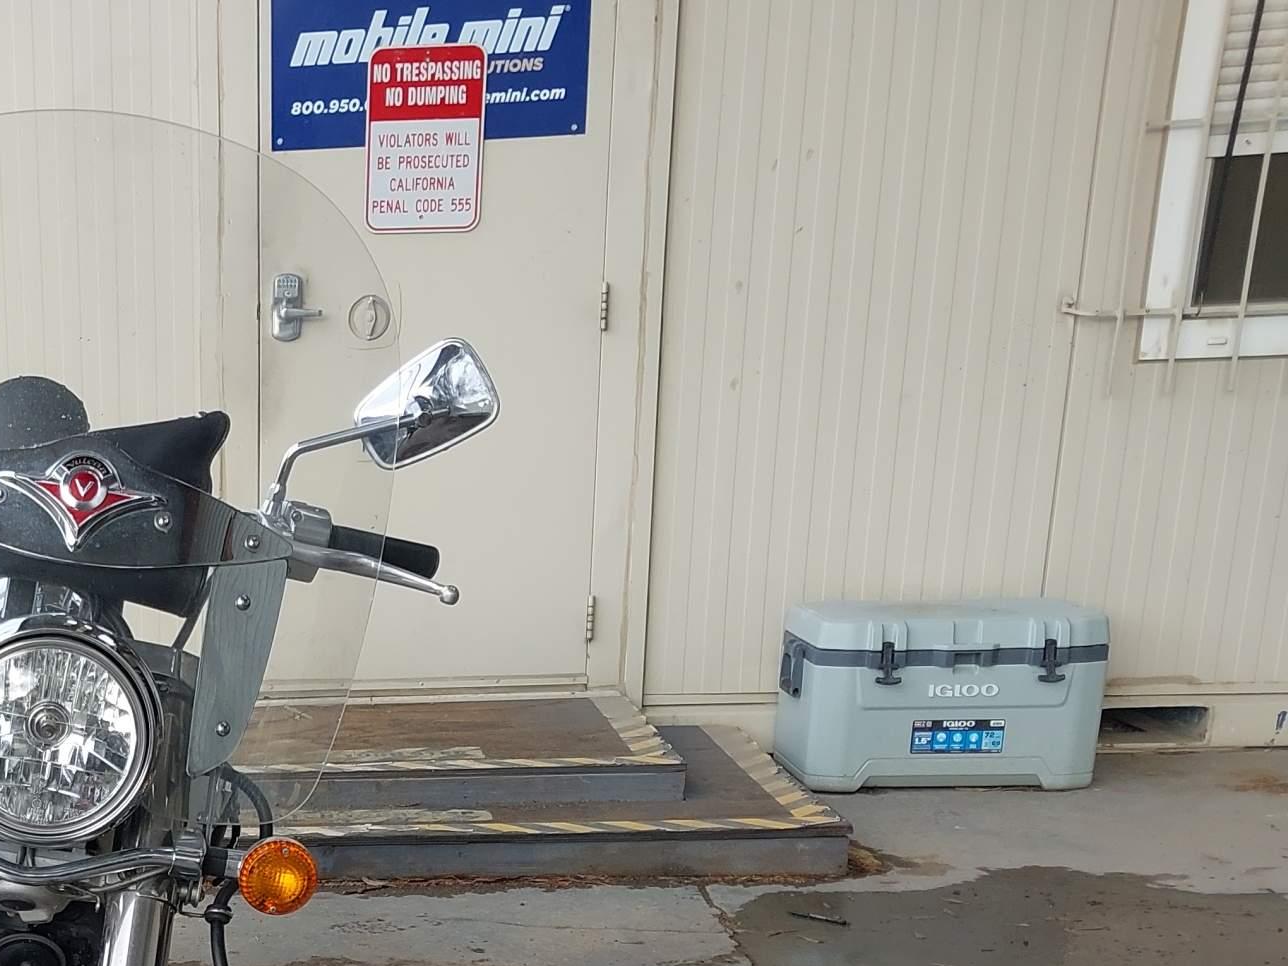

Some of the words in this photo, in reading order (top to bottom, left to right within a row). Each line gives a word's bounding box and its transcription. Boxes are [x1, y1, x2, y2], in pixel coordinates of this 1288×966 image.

[290, 7, 450, 67] mobile
[459, 5, 566, 55] mini
[373, 63, 391, 83] NO
[395, 60, 481, 82] TRESPASSING
[385, 87, 403, 107] NO
[408, 85, 467, 106] DUMPING
[290, 98, 368, 116] 800.950.
[378, 133, 438, 148] VIOLATORS
[445, 132, 471, 146] WILL
[377, 156, 391, 170] BE
[398, 154, 470, 169] PROSECUTED
[390, 177, 455, 192] CALIFORNIA
[372, 200, 409, 214] PENAL
[416, 199, 444, 213] CODE
[451, 198, 472, 212] 555
[928, 683, 1000, 697] IGLOO
[943, 720, 976, 728] IGLOO
